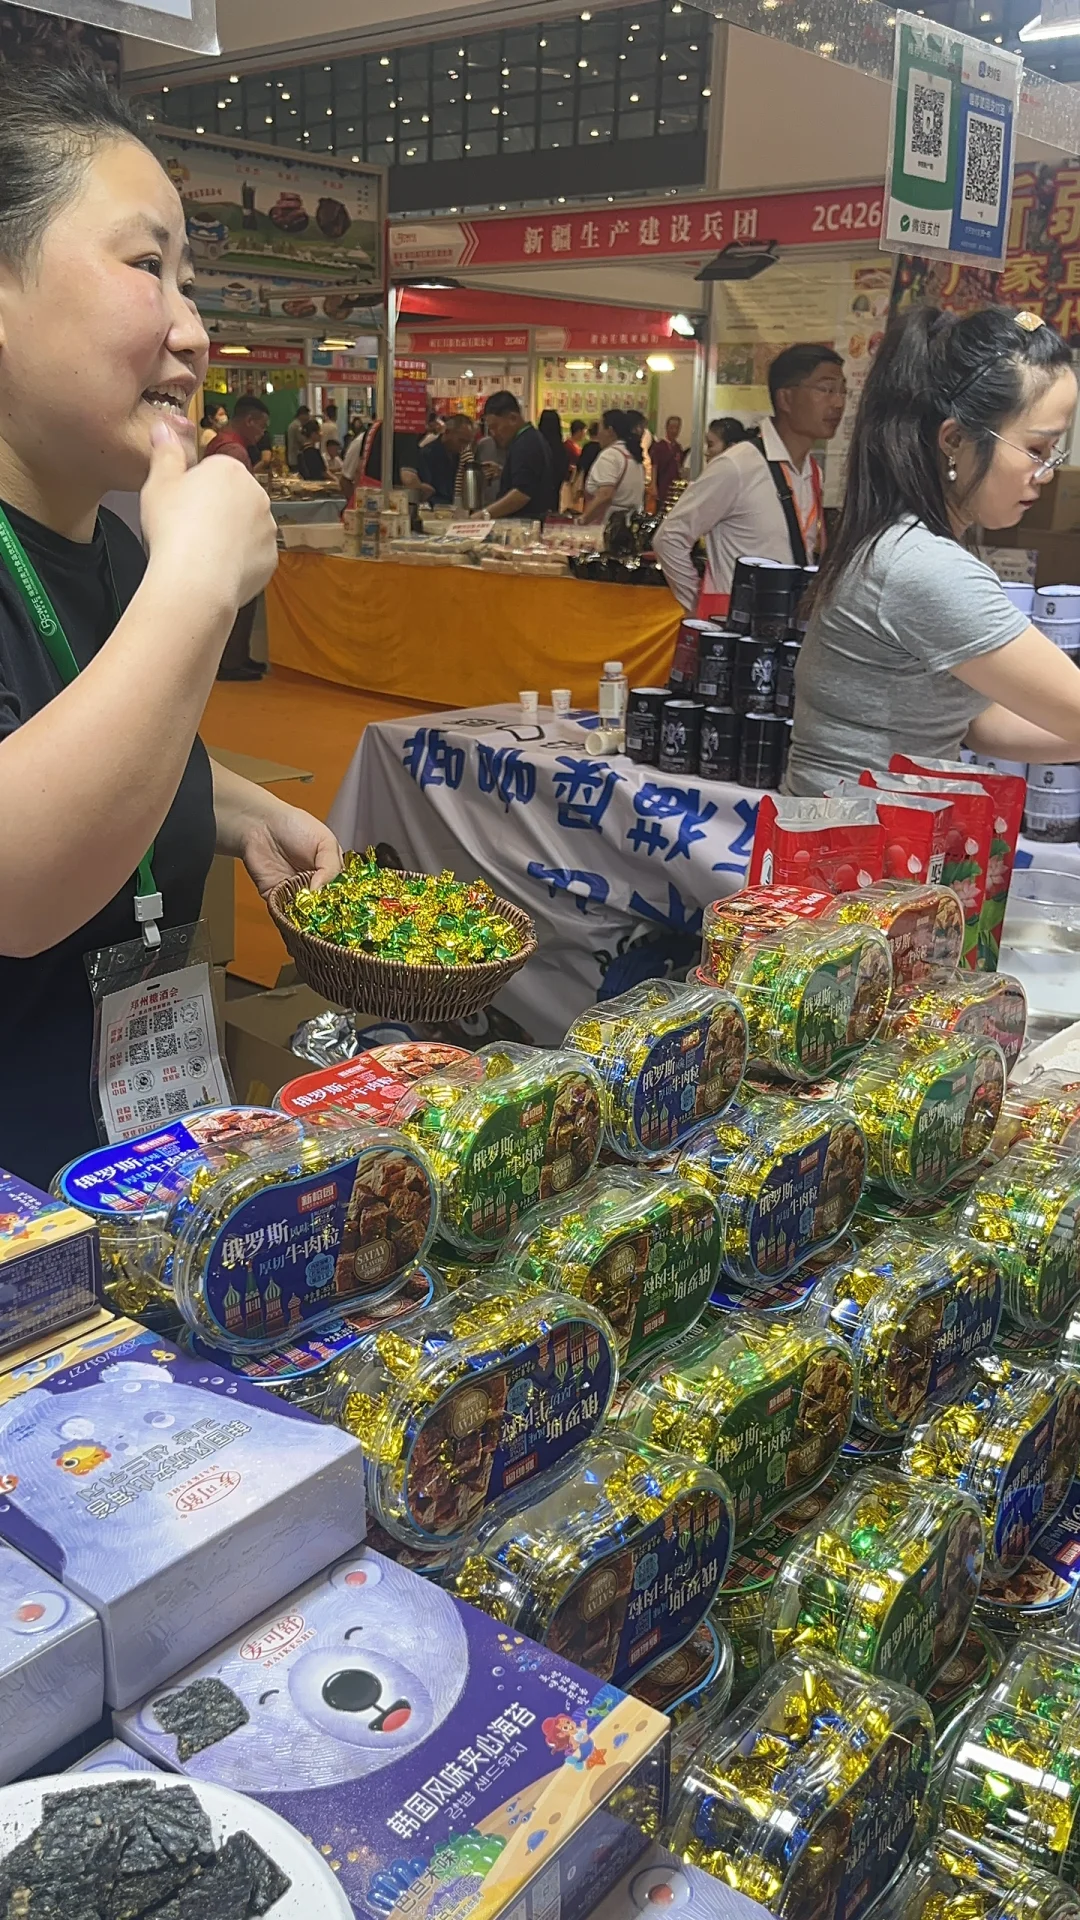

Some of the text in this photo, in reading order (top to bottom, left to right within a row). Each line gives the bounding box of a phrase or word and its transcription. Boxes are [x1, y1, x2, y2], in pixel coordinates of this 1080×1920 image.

[523, 208, 758, 254] 新疆生产建设兵团
[911, 218, 941, 237] 微信支付
[130, 987, 179, 1011] 郑州糖酒会
[803, 988, 831, 1017] 俄罗斯
[354, 1075, 398, 1097] 牛肉粒
[642, 1056, 676, 1093] 俄罗斯
[672, 1065, 700, 1092] 牛肉粒
[292, 1081, 346, 1108] 俄罗斯
[918, 1102, 948, 1133] 俄罗斯
[472, 1133, 514, 1175] 俄罗斯
[509, 1141, 545, 1173] 牛肉粒
[74, 1157, 141, 1189] 俄罗斯
[759, 1180, 793, 1218] 俄罗斯
[789, 1185, 818, 1216] 牛肉粒
[221, 1218, 289, 1264] 俄罗斯
[285, 1227, 341, 1264] 牛肉粒
[356, 1246, 386, 1266] SATAY
[360, 1256, 385, 1272] FLAVOR
[643, 1262, 679, 1297] 牛肉粒
[673, 1262, 711, 1303] 俄罗斯
[962, 1318, 992, 1356] 俄罗斯
[457, 1407, 488, 1431] SATAY
[545, 1391, 600, 1444] 俄罗斯
[715, 1422, 760, 1471] 俄罗斯
[755, 1428, 792, 1463] 牛肉粒
[85, 1419, 252, 1520] 韩国风味夹心海苔
[167, 1464, 220, 1498] MAIKESHU
[179, 1472, 235, 1511] 麦可舒
[586, 1589, 617, 1613] SATAY
[627, 1573, 673, 1621] 牛肉粒
[668, 1558, 718, 1617] 俄罗斯
[242, 1616, 300, 1660] 麦可舒
[262, 1628, 316, 1669] MAIKESHU
[880, 1607, 916, 1670] 俄罗斯
[386, 1702, 537, 1840] 韩国风味夹心海苔
[475, 1741, 528, 1792] 샌드위치
[395, 1849, 461, 1914] 巴旦木味
[426, 1871, 486, 1920] 含量:65克
